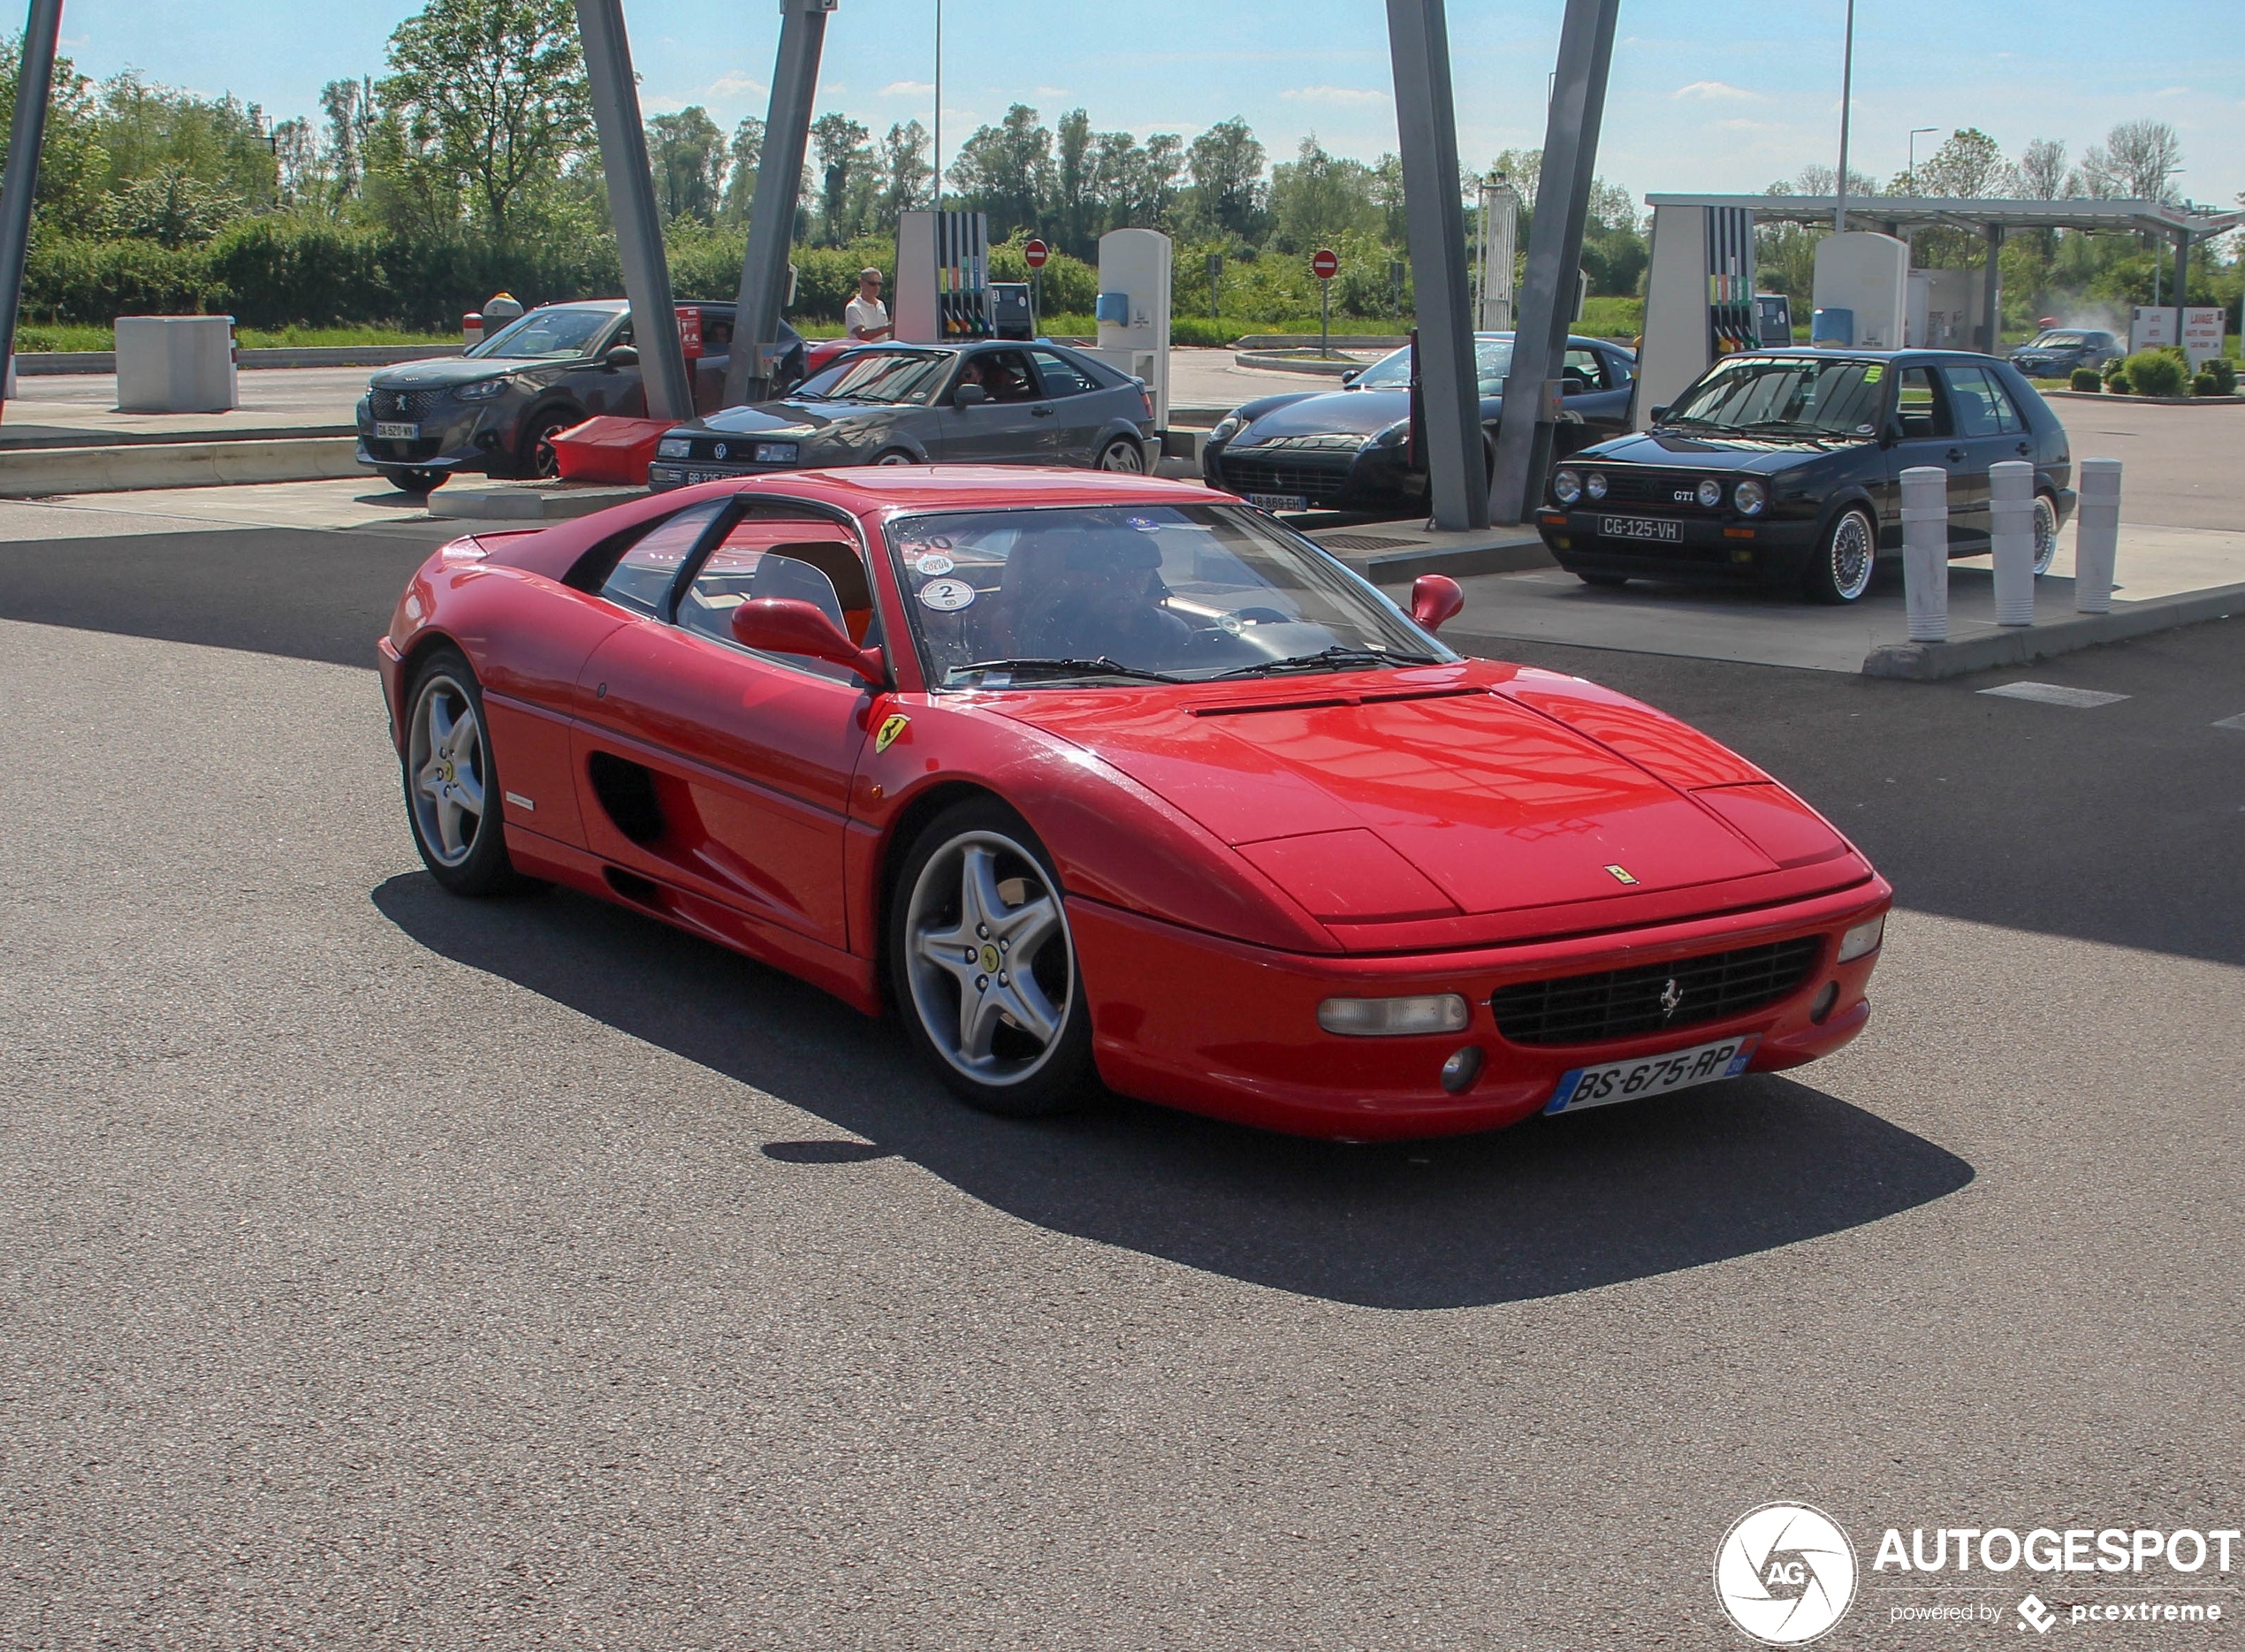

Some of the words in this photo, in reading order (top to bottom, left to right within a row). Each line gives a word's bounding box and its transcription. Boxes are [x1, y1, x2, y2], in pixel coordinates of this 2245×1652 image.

[1674, 491, 1694, 501] GTI
[1604, 518, 1677, 539] CG-125-VH
[939, 585, 955, 598] 2
[1727, 1058, 1747, 1072] 30
[1570, 1045, 1736, 1103] BS-675-AP
